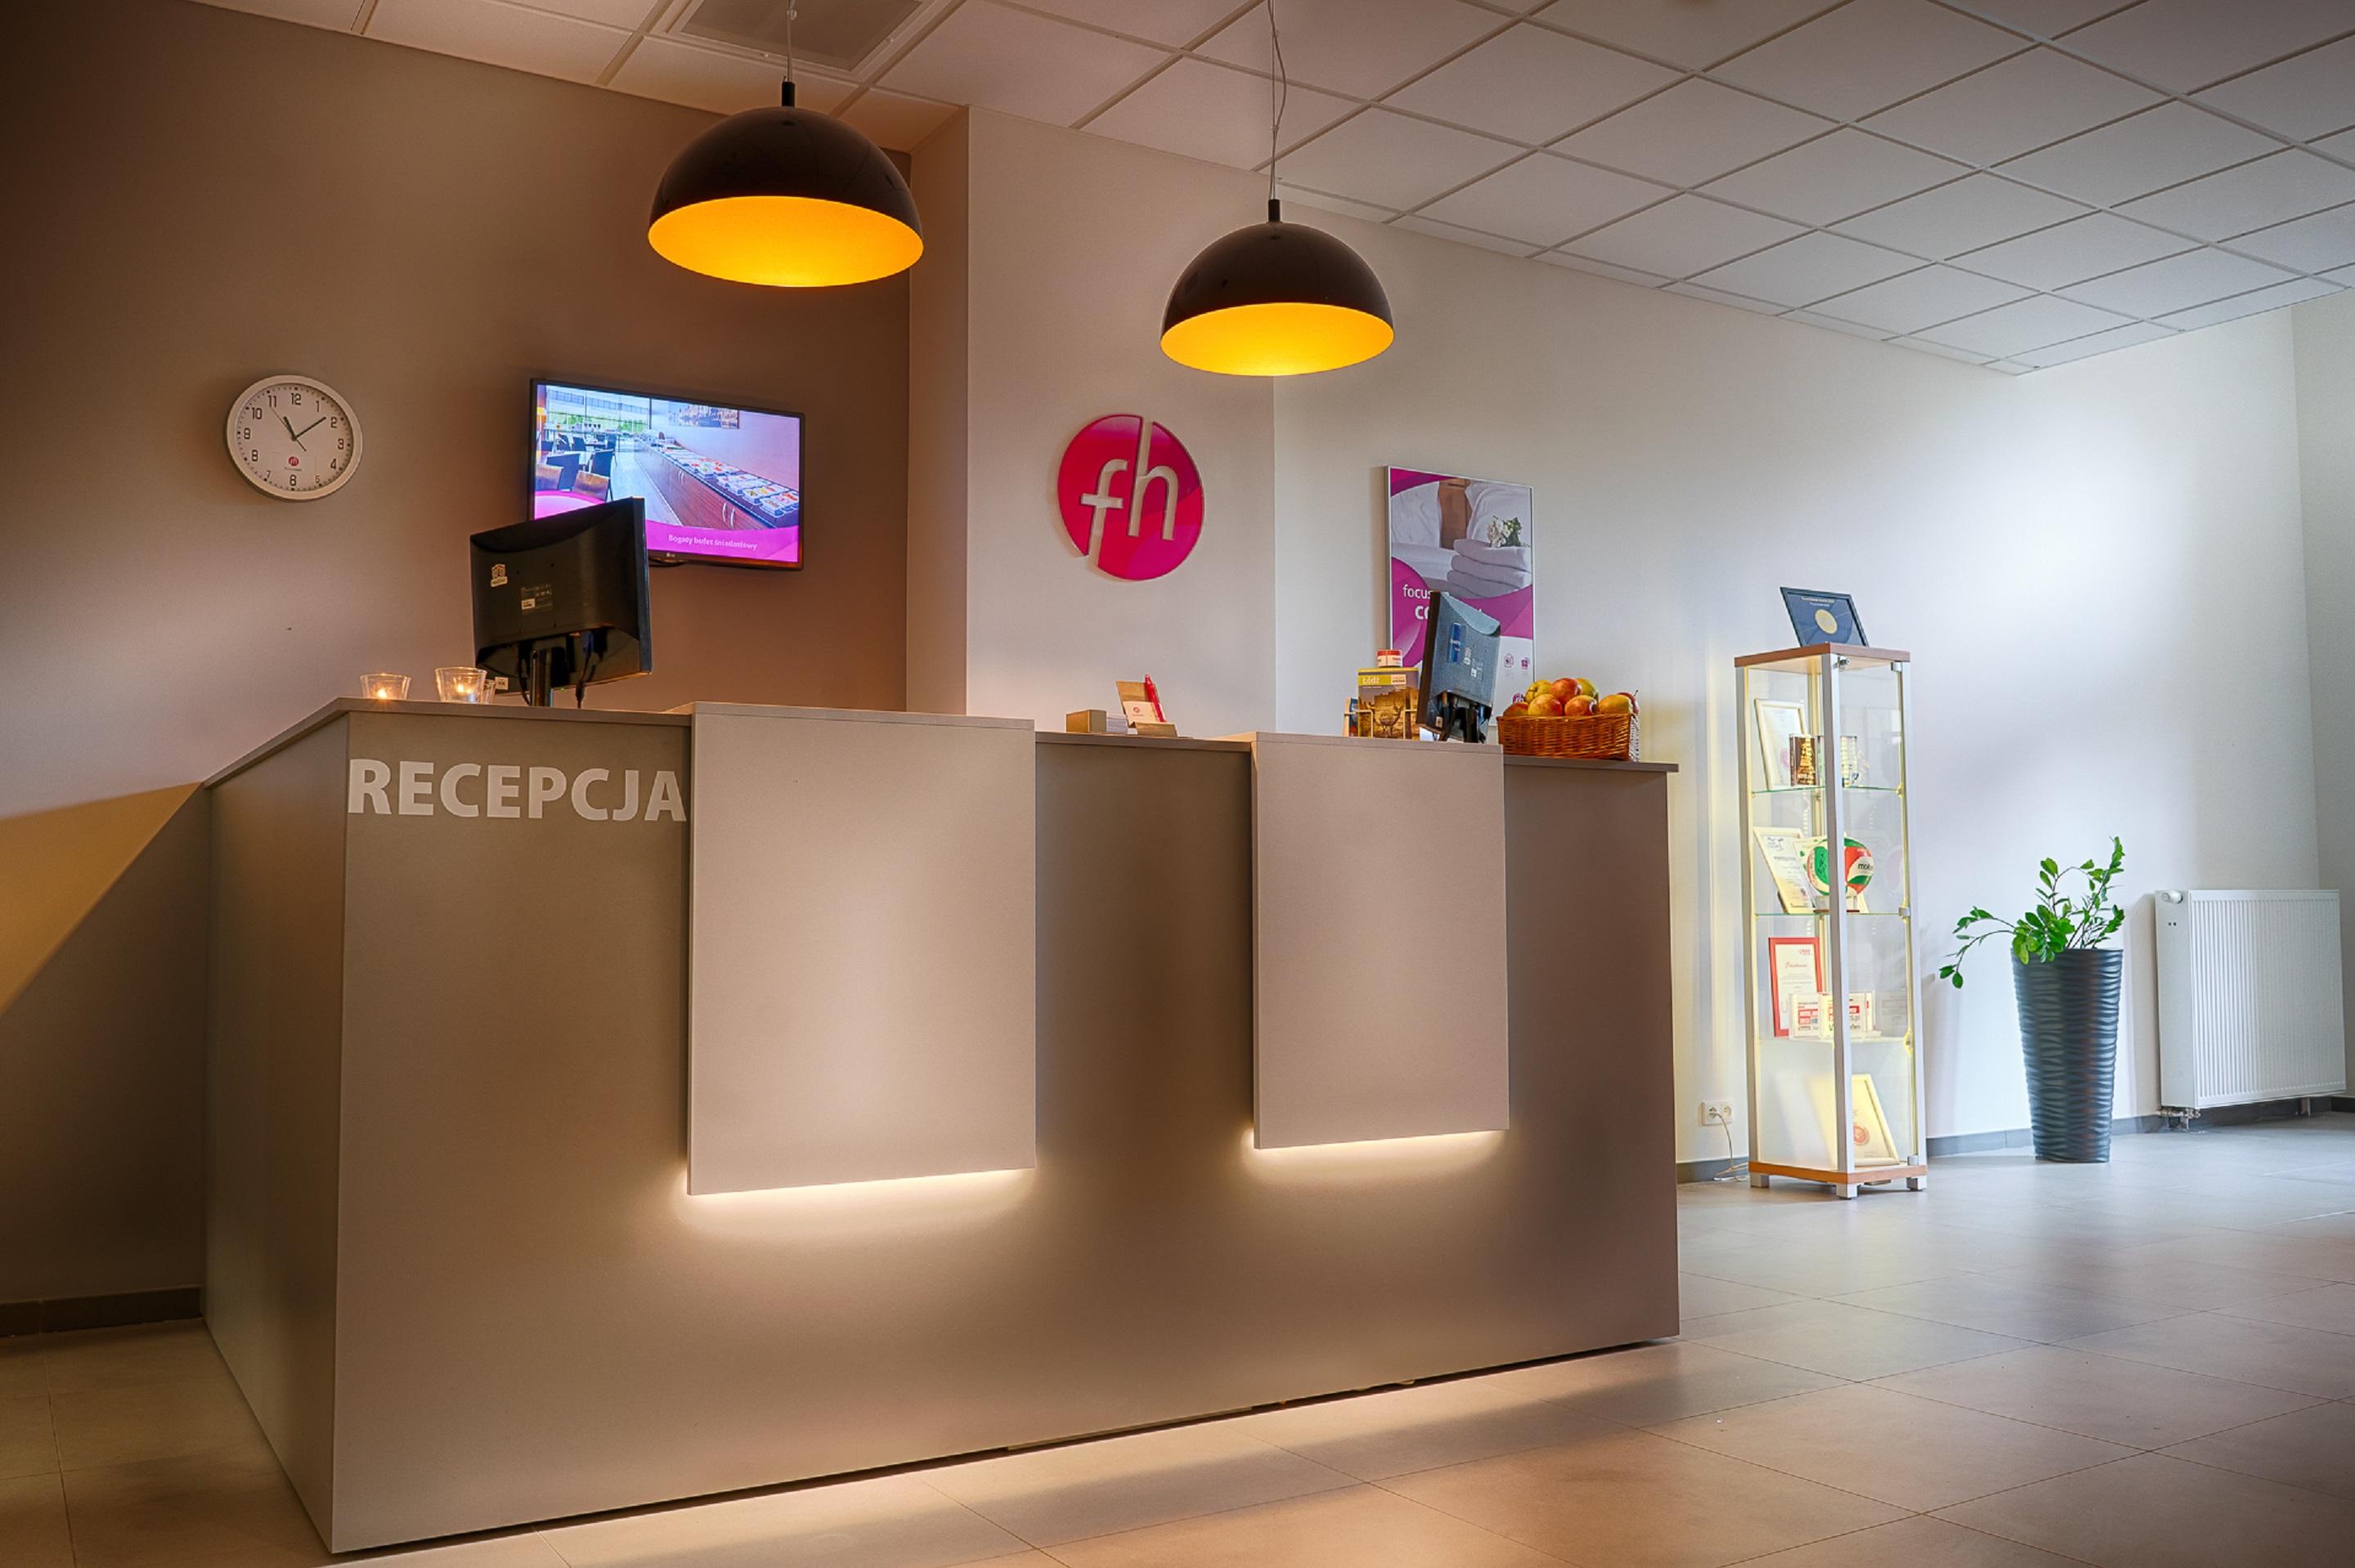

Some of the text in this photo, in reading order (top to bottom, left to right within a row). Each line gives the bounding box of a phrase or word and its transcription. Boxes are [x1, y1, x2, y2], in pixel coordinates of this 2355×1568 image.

[267, 395, 277, 408] 11
[290, 392, 302, 405] 12
[316, 400, 320, 413] 1
[251, 407, 262, 420] 10
[330, 416, 339, 428] 2
[244, 428, 251, 440] 9
[337, 438, 344, 450] 3
[251, 450, 258, 462] 8
[330, 458, 337, 470] 4
[266, 470, 271, 479] 7
[289, 474, 297, 486] 6
[315, 475, 321, 484] 5
[1080, 419, 1179, 567] fh
[668, 534, 694, 545] Bogaty
[693, 536, 714, 546] bufet
[348, 759, 688, 822] RECEPCJA
